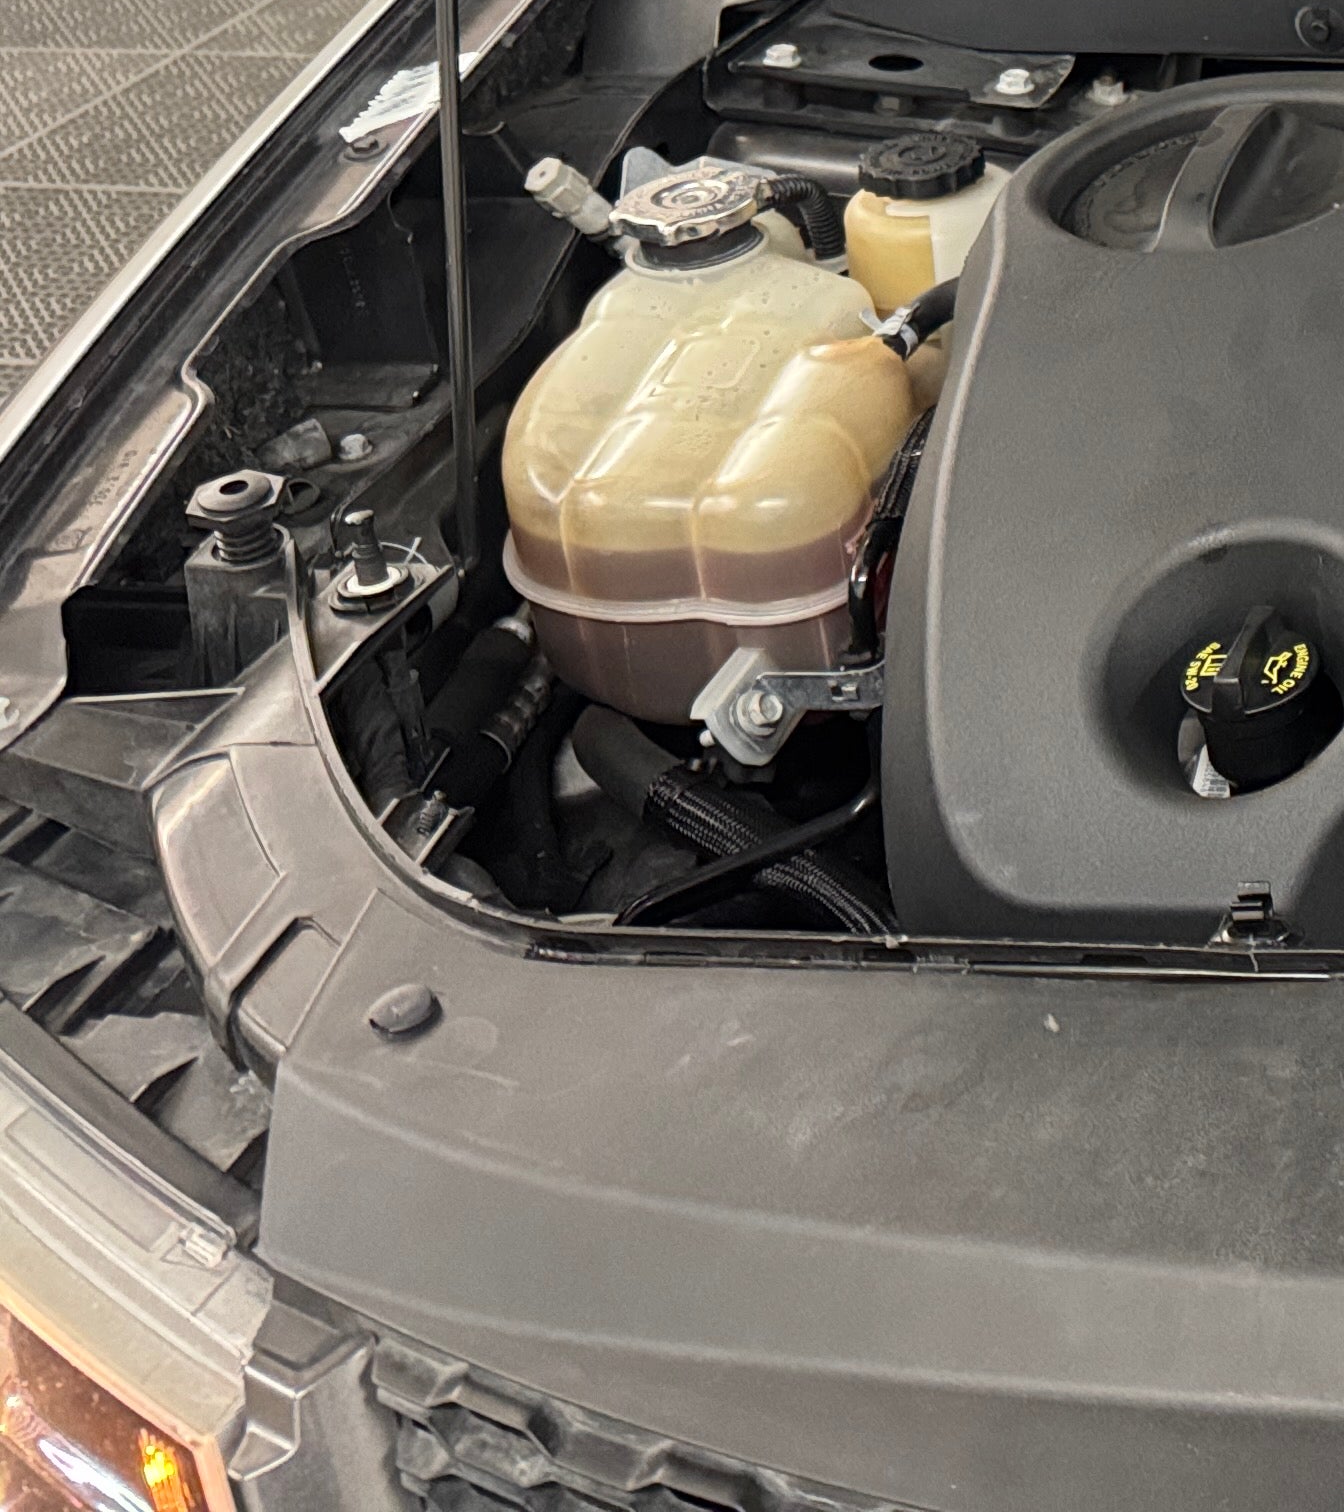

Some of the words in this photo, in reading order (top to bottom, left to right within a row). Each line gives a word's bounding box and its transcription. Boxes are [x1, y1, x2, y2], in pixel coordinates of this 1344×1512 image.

[1196, 642, 1221, 660] SAE
[1290, 643, 1310, 678] ENGINE
[1271, 679, 1296, 694] OIL
